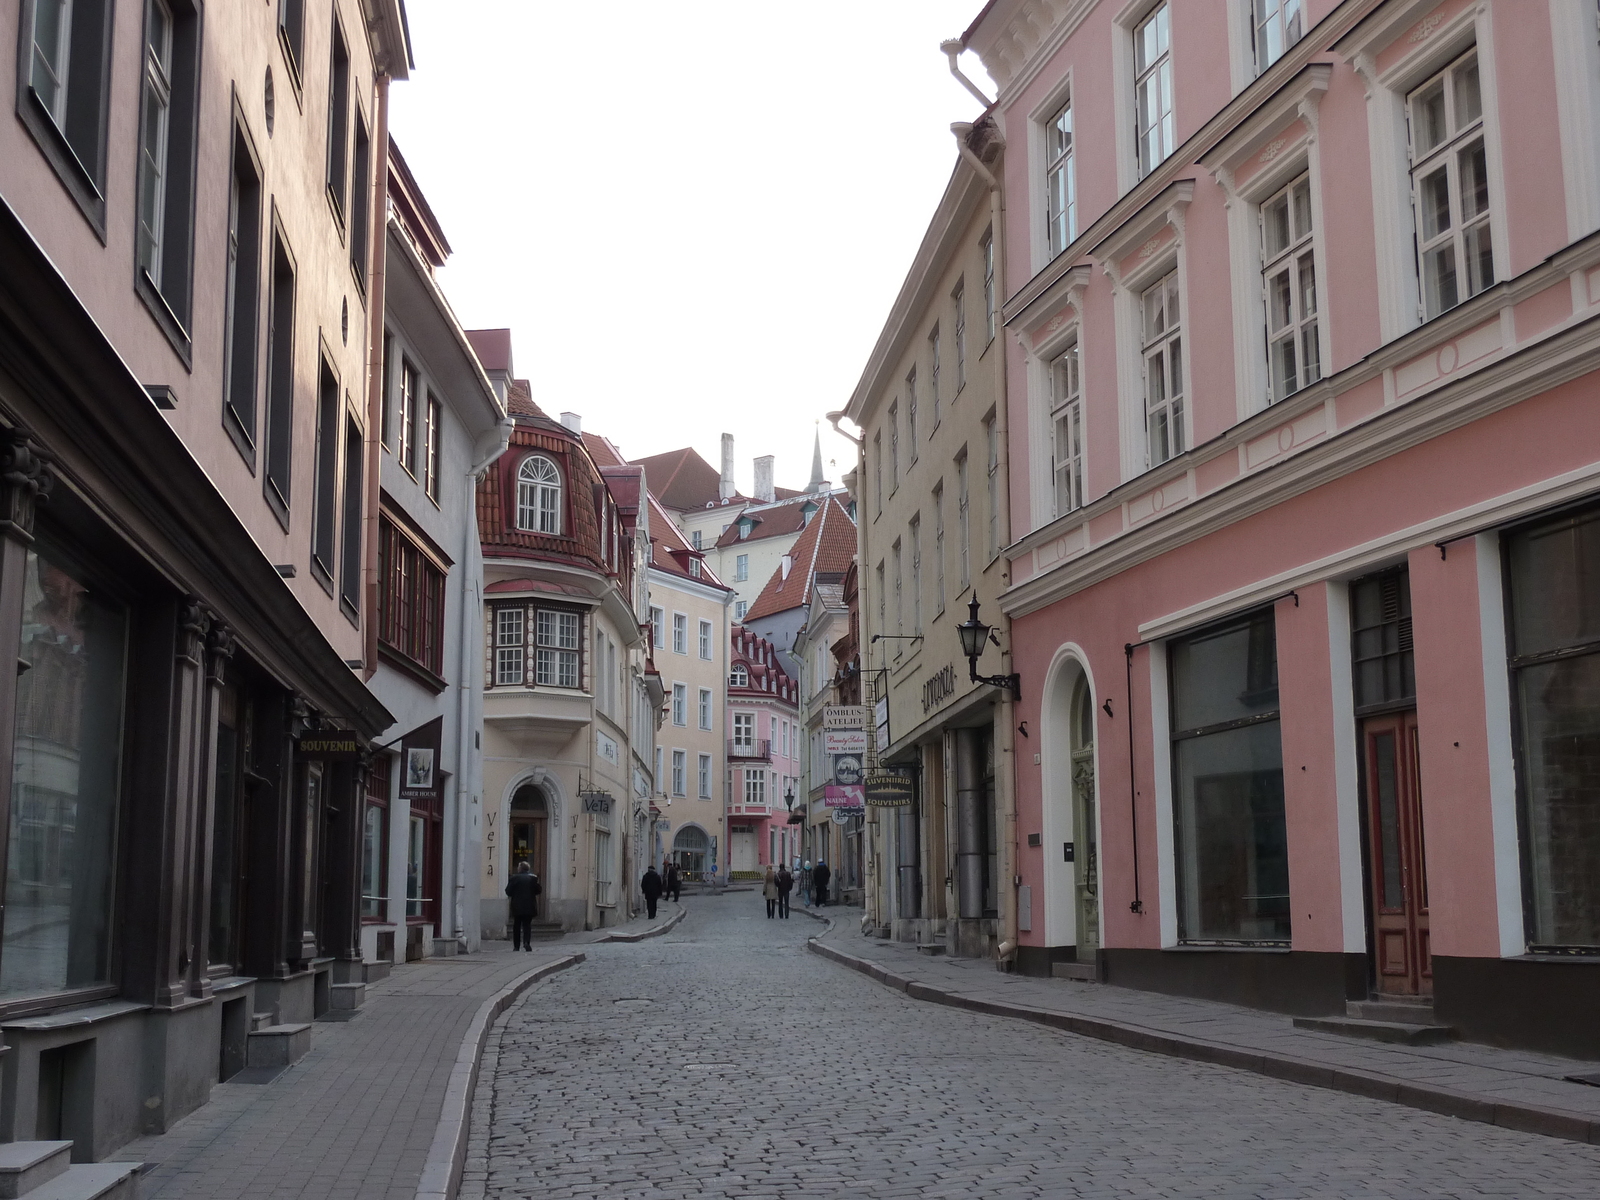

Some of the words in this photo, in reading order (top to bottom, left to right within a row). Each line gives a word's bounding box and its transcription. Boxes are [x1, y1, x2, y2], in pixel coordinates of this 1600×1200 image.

[826, 734, 848, 746] Beauty
[848, 734, 865, 744] Salon
[300, 740, 357, 752] SOUVENIR
[867, 776, 911, 786] SUVENIIRID
[867, 798, 911, 807] SOUVENIRS
